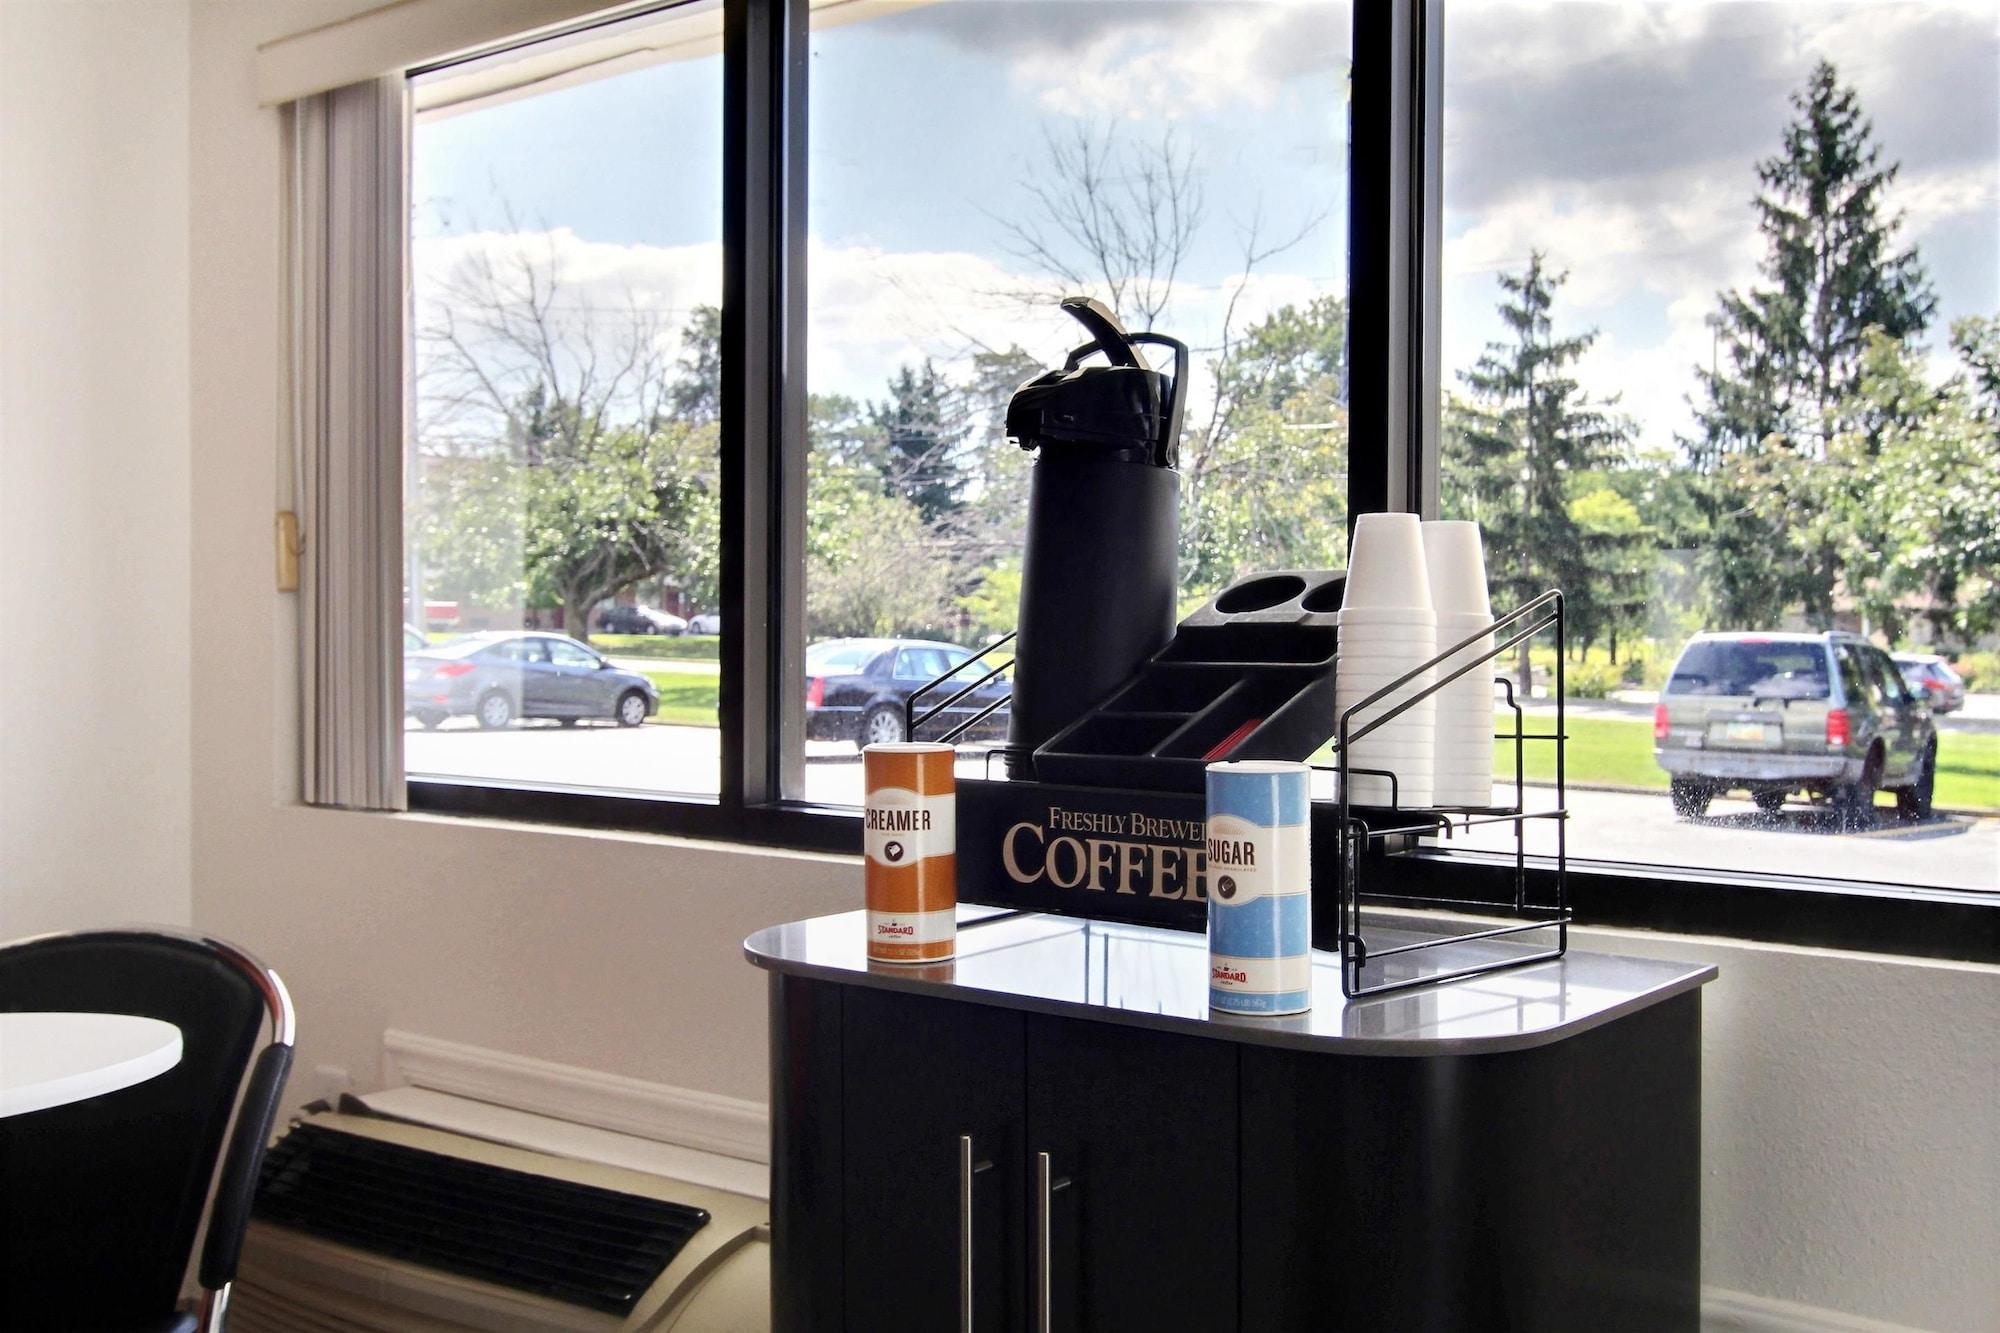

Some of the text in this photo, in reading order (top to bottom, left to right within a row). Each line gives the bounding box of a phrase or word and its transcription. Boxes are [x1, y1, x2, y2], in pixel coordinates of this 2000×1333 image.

[866, 808, 931, 831] CREAMER
[1208, 838, 1255, 866] SUGAR
[877, 924, 914, 936] STANDARD
[1211, 967, 1246, 983] STANDARD
